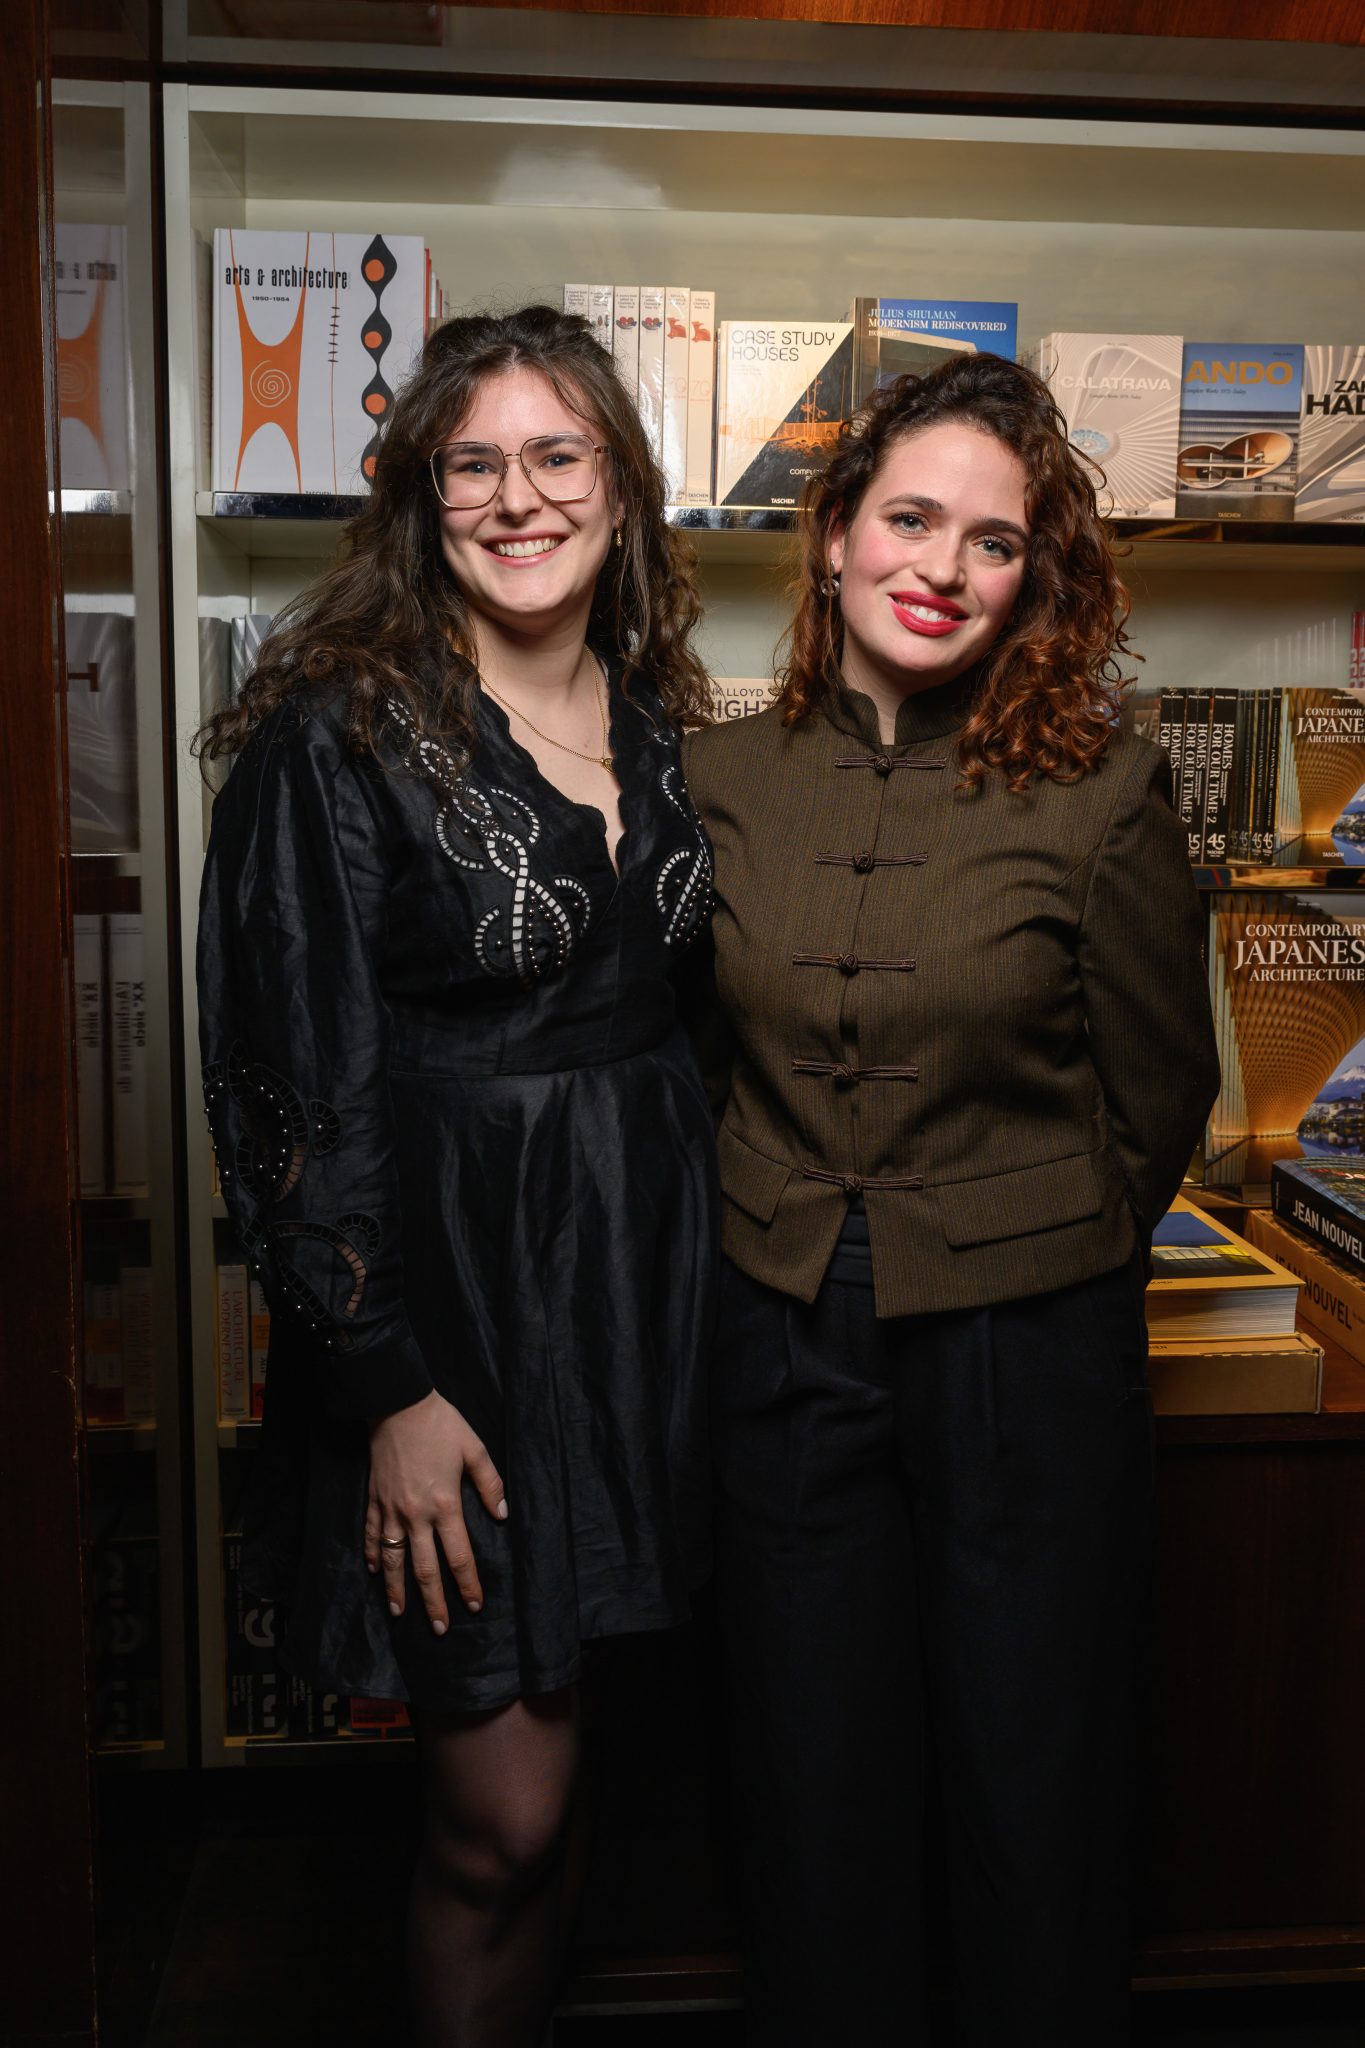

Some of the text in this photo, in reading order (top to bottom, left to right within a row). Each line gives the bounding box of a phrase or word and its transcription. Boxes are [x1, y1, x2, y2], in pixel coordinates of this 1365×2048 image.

[225, 264, 348, 289] arts & architecture
[868, 309, 957, 320] JULIUS SHULMAN
[868, 319, 1007, 332] MODERNISM REDISCOVERED
[731, 329, 835, 346] CASE STUDY
[731, 346, 799, 362] HOUSES
[1061, 375, 1172, 391] CALATRAVA
[1184, 361, 1293, 385] ANDO
[727, 688, 764, 697] LLOYD
[1170, 723, 1183, 769] HOMES
[1195, 723, 1208, 769] HOMES
[1221, 724, 1235, 770] HOMES
[1181, 723, 1197, 824] FOR OUR TIME 2
[1207, 723, 1224, 824] FOR OUR TIME 2
[1206, 832, 1226, 850] 45
[1263, 832, 1274, 850] 45
[1233, 940, 1365, 970] JAPANES
[1249, 969, 1365, 981] ARCHITECTURE
[1292, 1200, 1365, 1264] JEAN NOUVEL
[1304, 1274, 1353, 1330] NOUVEL
